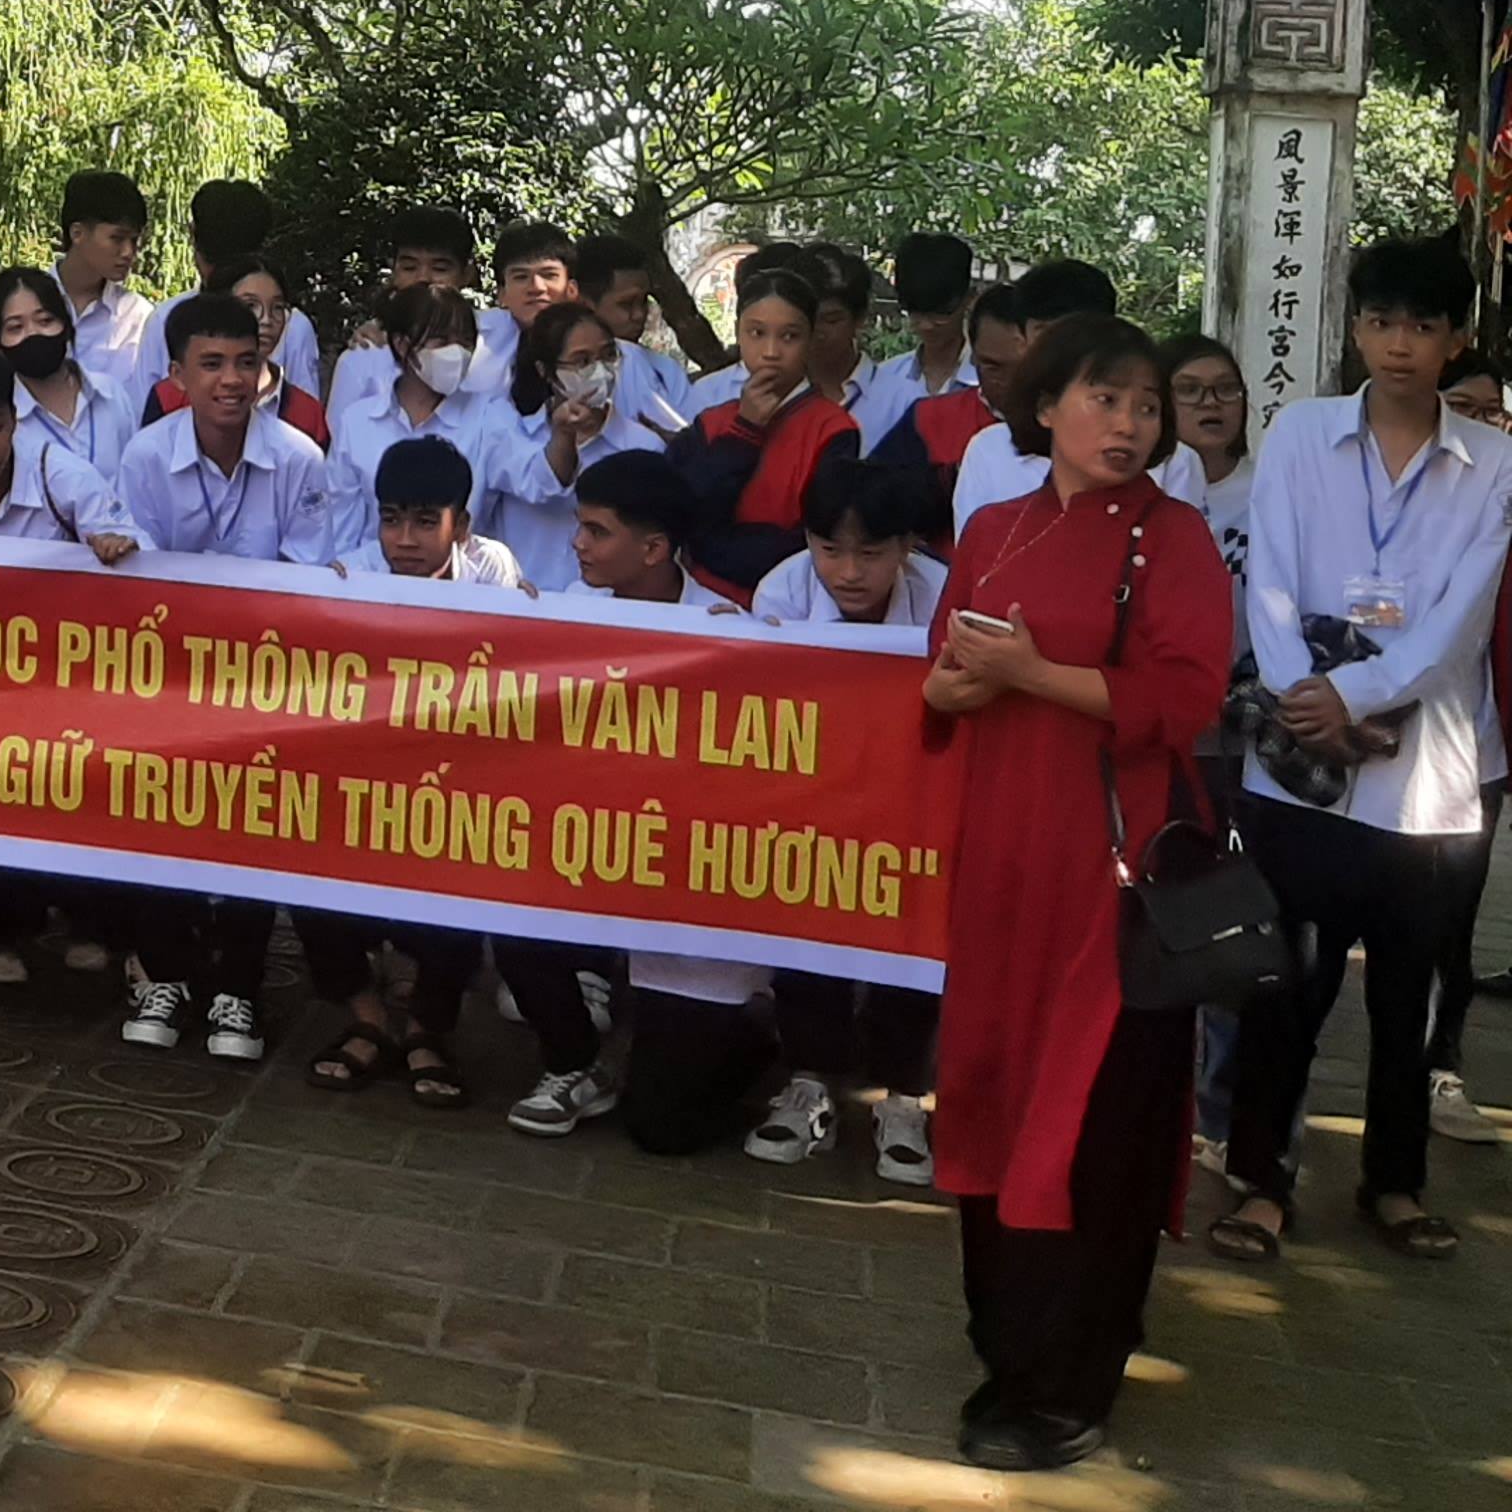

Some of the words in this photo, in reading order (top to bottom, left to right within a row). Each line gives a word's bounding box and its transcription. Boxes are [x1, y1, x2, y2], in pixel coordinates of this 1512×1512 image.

[56, 603, 169, 699] PHỔ
[183, 629, 368, 723] THÔNG
[387, 641, 539, 742] TRẦN
[559, 665, 679, 758] VĂN
[698, 690, 819, 775] LAN
[104, 745, 320, 842] TRUYỀN
[338, 761, 531, 870] THỐNG
[551, 798, 668, 887] QUÊ
[688, 820, 939, 918] HƯƠNG"
